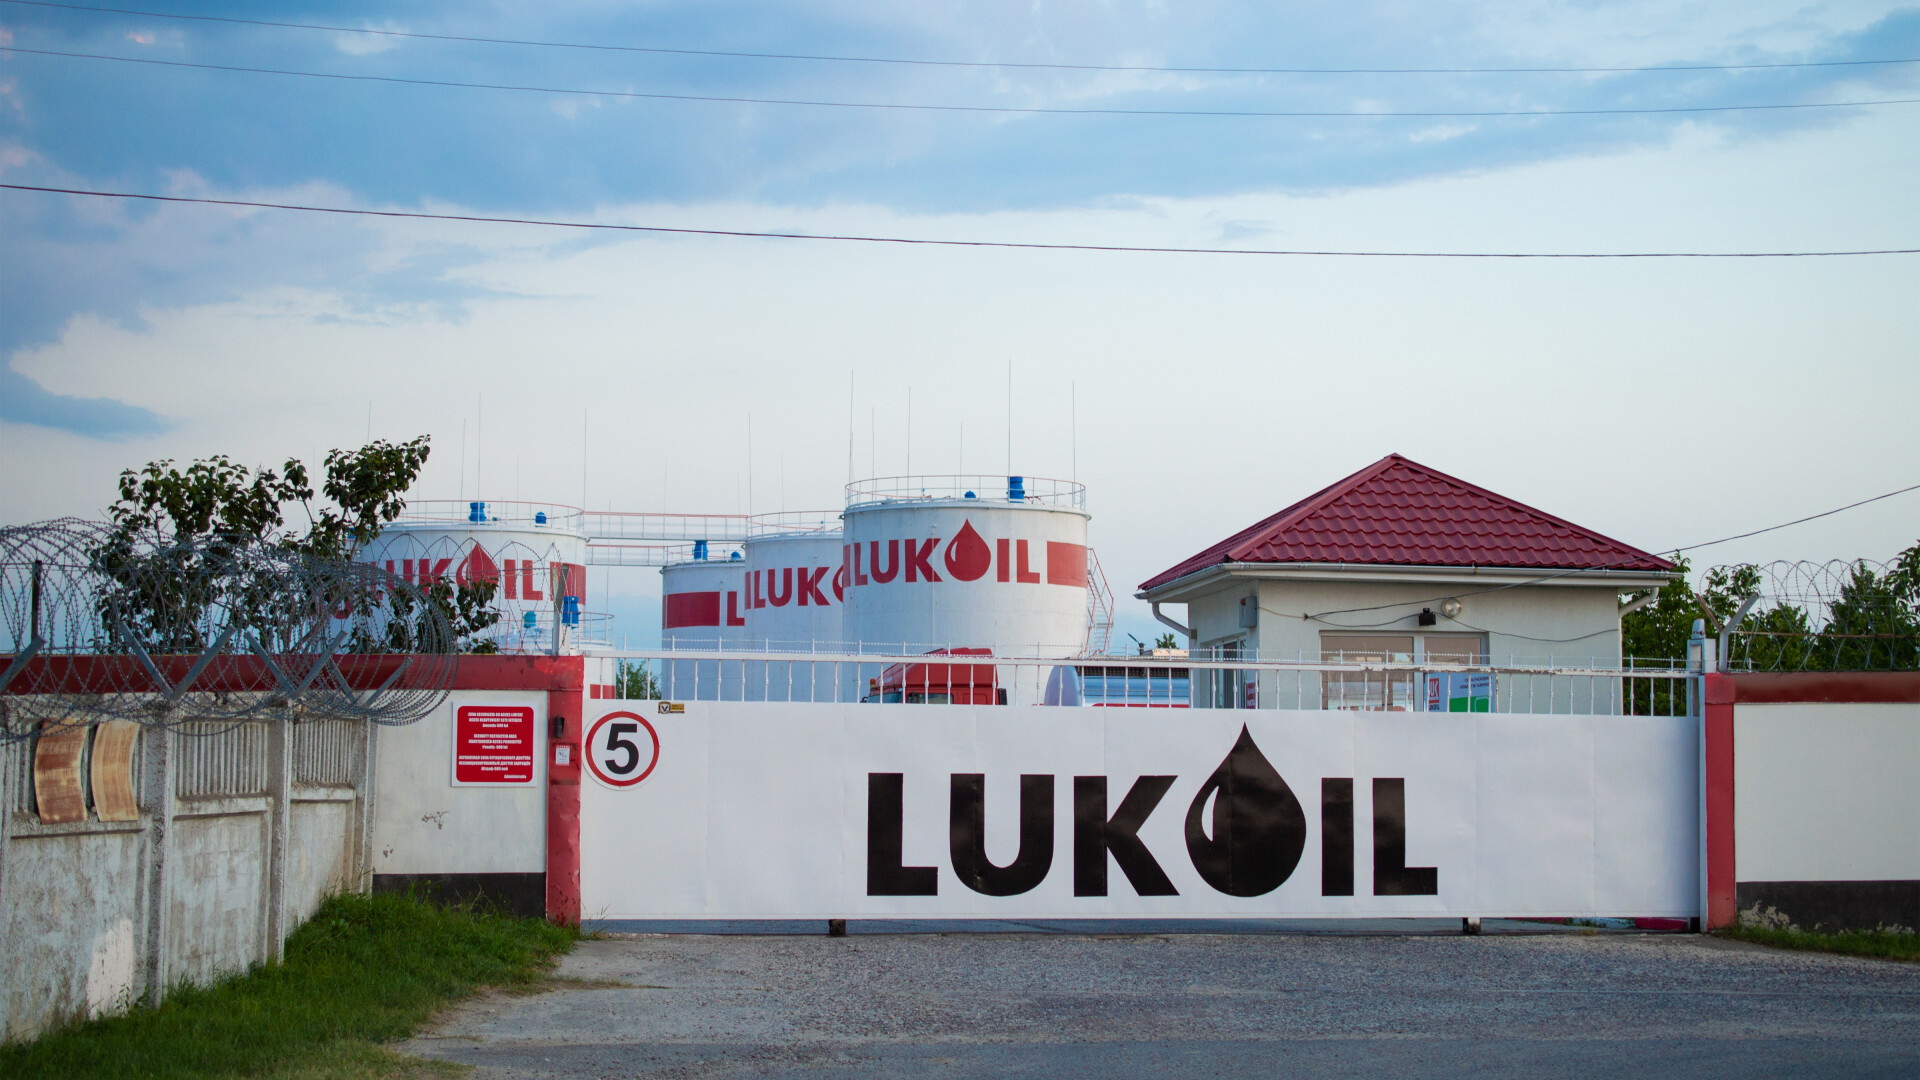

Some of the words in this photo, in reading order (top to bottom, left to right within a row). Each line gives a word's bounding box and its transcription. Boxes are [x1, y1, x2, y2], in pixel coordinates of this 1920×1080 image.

[854, 518, 1040, 586] LUKOIL
[605, 723, 640, 775] 5
[867, 722, 1438, 897] LUKOIL
